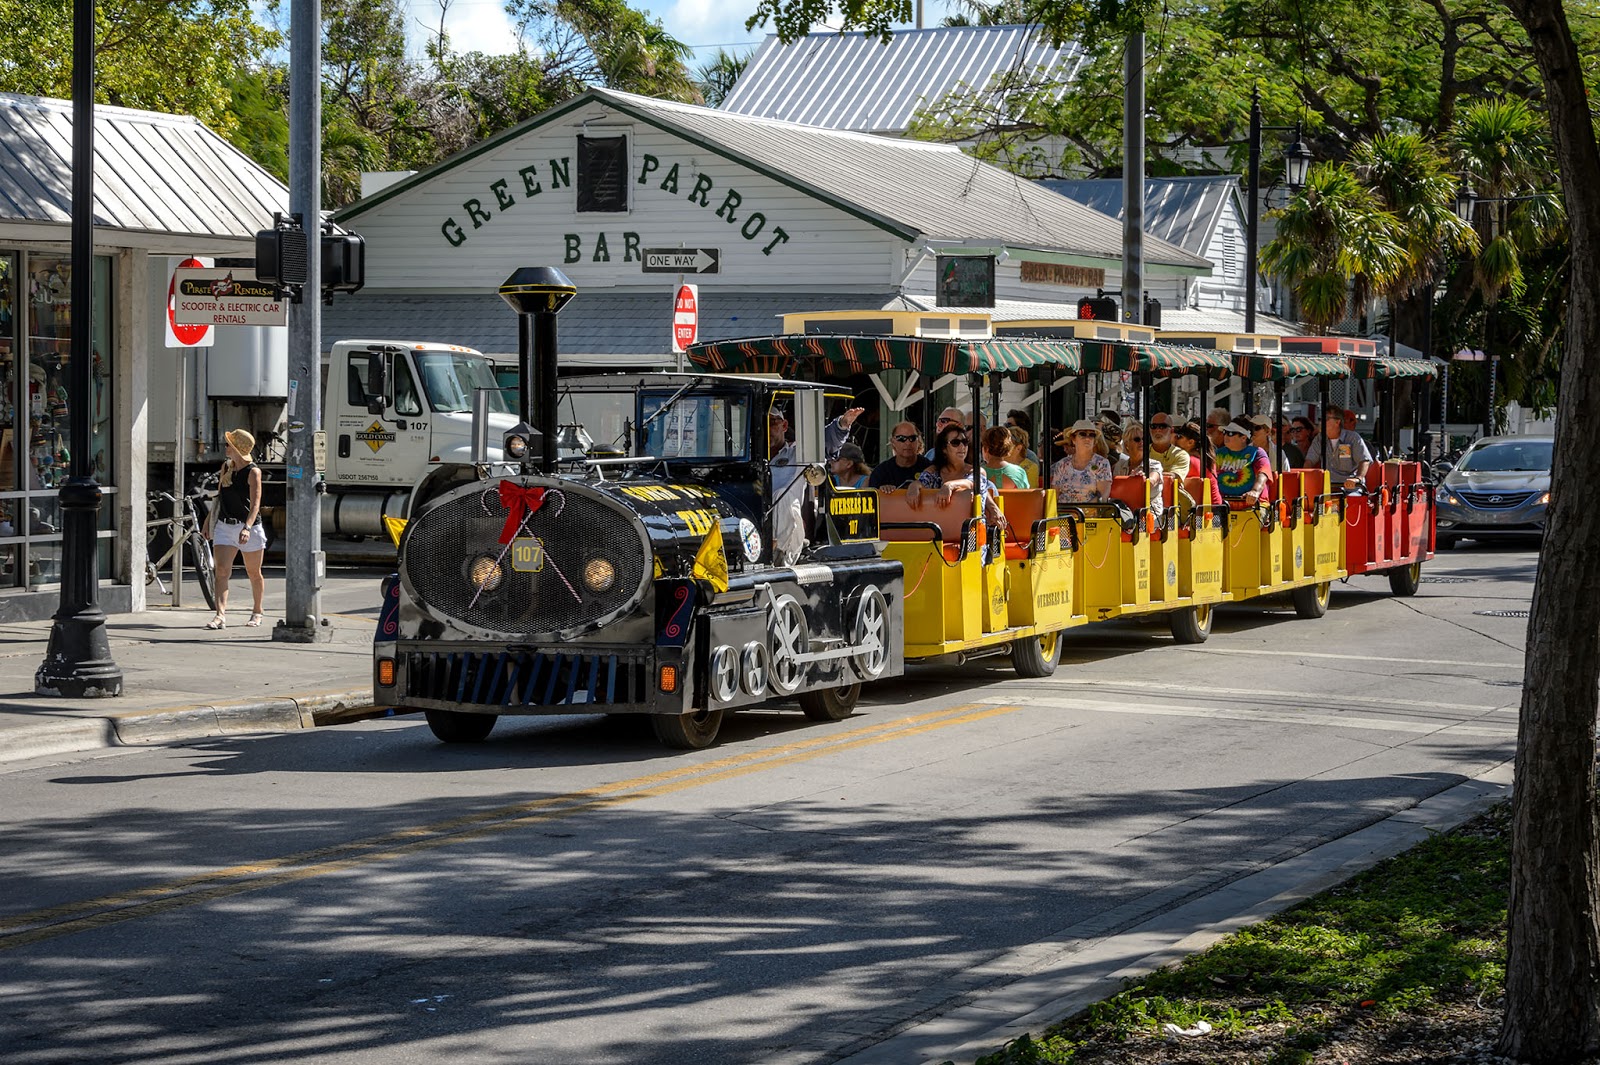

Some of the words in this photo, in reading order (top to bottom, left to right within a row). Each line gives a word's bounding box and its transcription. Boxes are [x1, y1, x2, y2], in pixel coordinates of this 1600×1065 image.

[441, 157, 570, 247] GREEN
[638, 153, 790, 256] PARROT
[563, 231, 642, 264] BAR
[650, 255, 670, 266] ONE
[674, 255, 695, 266] WAY
[186, 283, 211, 294] PIRATE
[181, 302, 217, 312] SCOOTER
[219, 303, 226, 311] &
[228, 303, 261, 313] ELECTRIC
[263, 304, 280, 313] CAR
[677, 298, 684, 309] DO
[685, 298, 694, 309] NOT
[213, 315, 247, 324] RENTALS
[677, 327, 693, 339] ENTER
[410, 422, 428, 430] 107
[375, 433, 395, 441] COAST
[830, 498, 861, 515] OVERSEAS
[862, 497, 875, 513] R.R.
[849, 520, 858, 534] 107
[515, 546, 541, 562] 107
[1037, 592, 1060, 608] OVERSEAS
